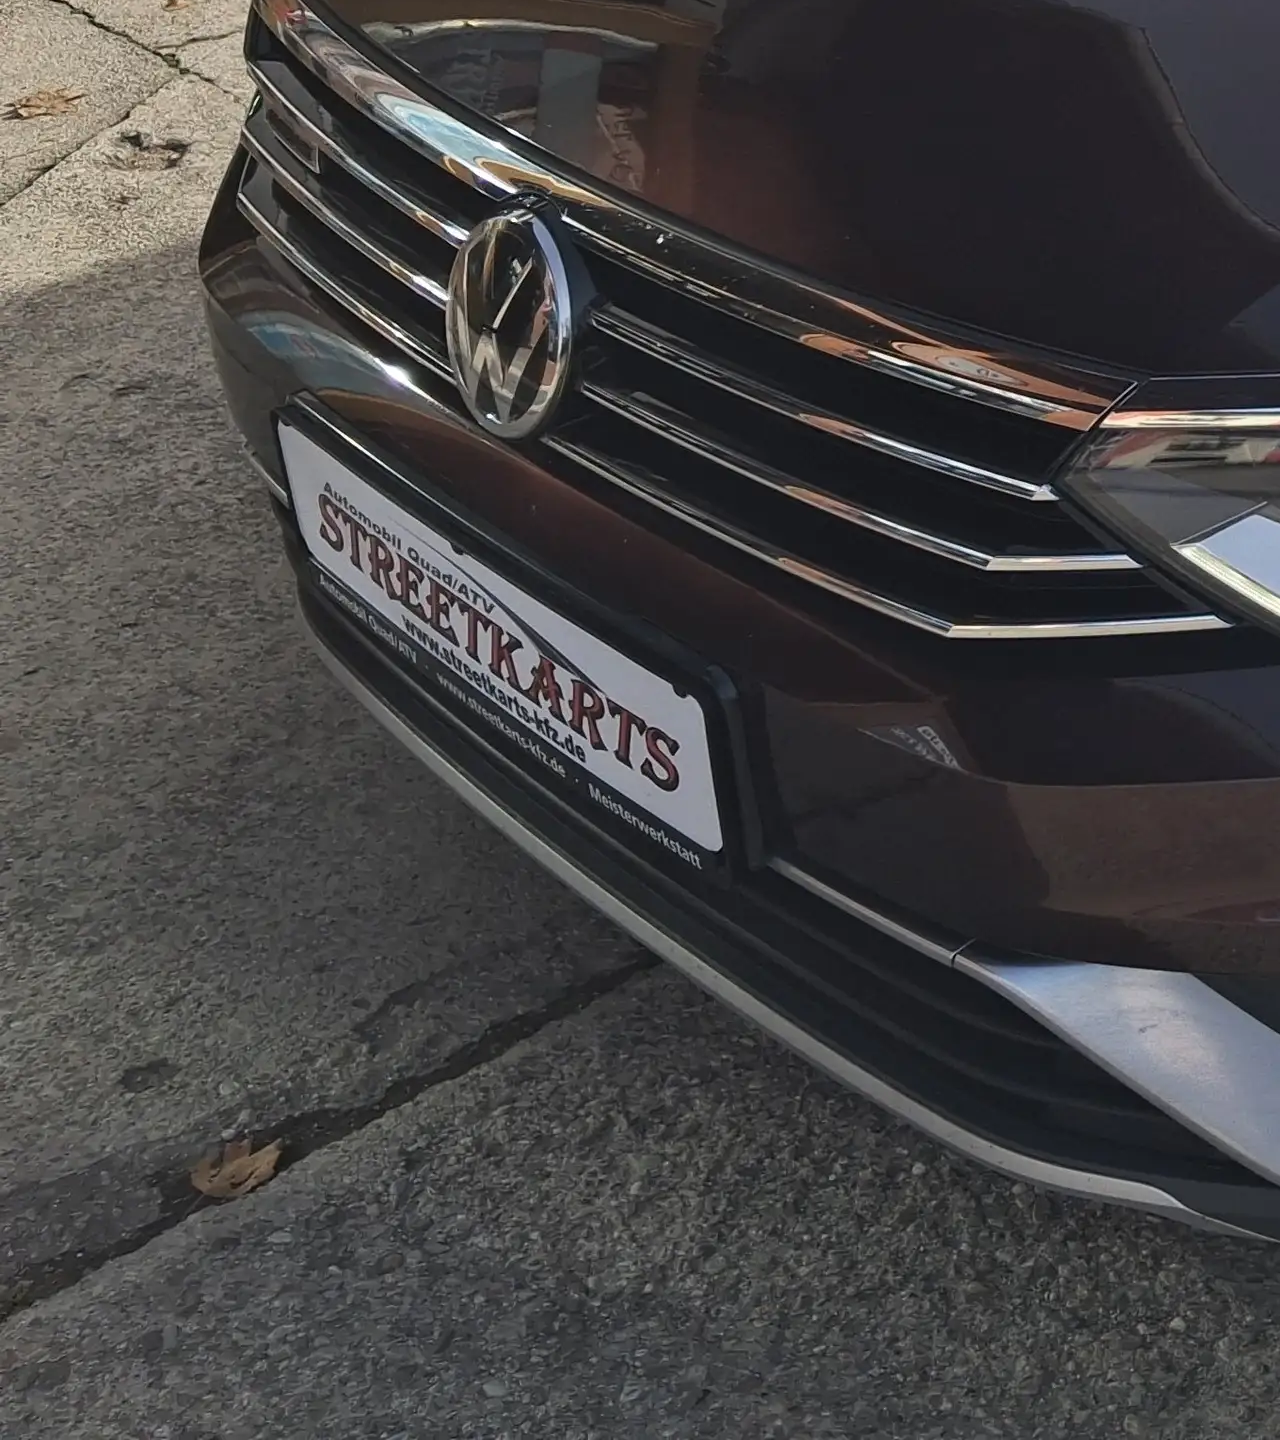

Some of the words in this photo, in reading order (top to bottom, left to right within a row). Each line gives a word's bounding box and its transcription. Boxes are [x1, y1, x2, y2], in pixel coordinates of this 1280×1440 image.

[324, 482, 402, 550] Automobil
[407, 546, 496, 614] Quad/ATV
[318, 493, 680, 792] STREETKARTS
[401, 614, 587, 763] www.streetkarts-kfz.de
[436, 672, 567, 778] www.streetkarts-kfz.de
[588, 782, 703, 870] Meisterwerkstatt
